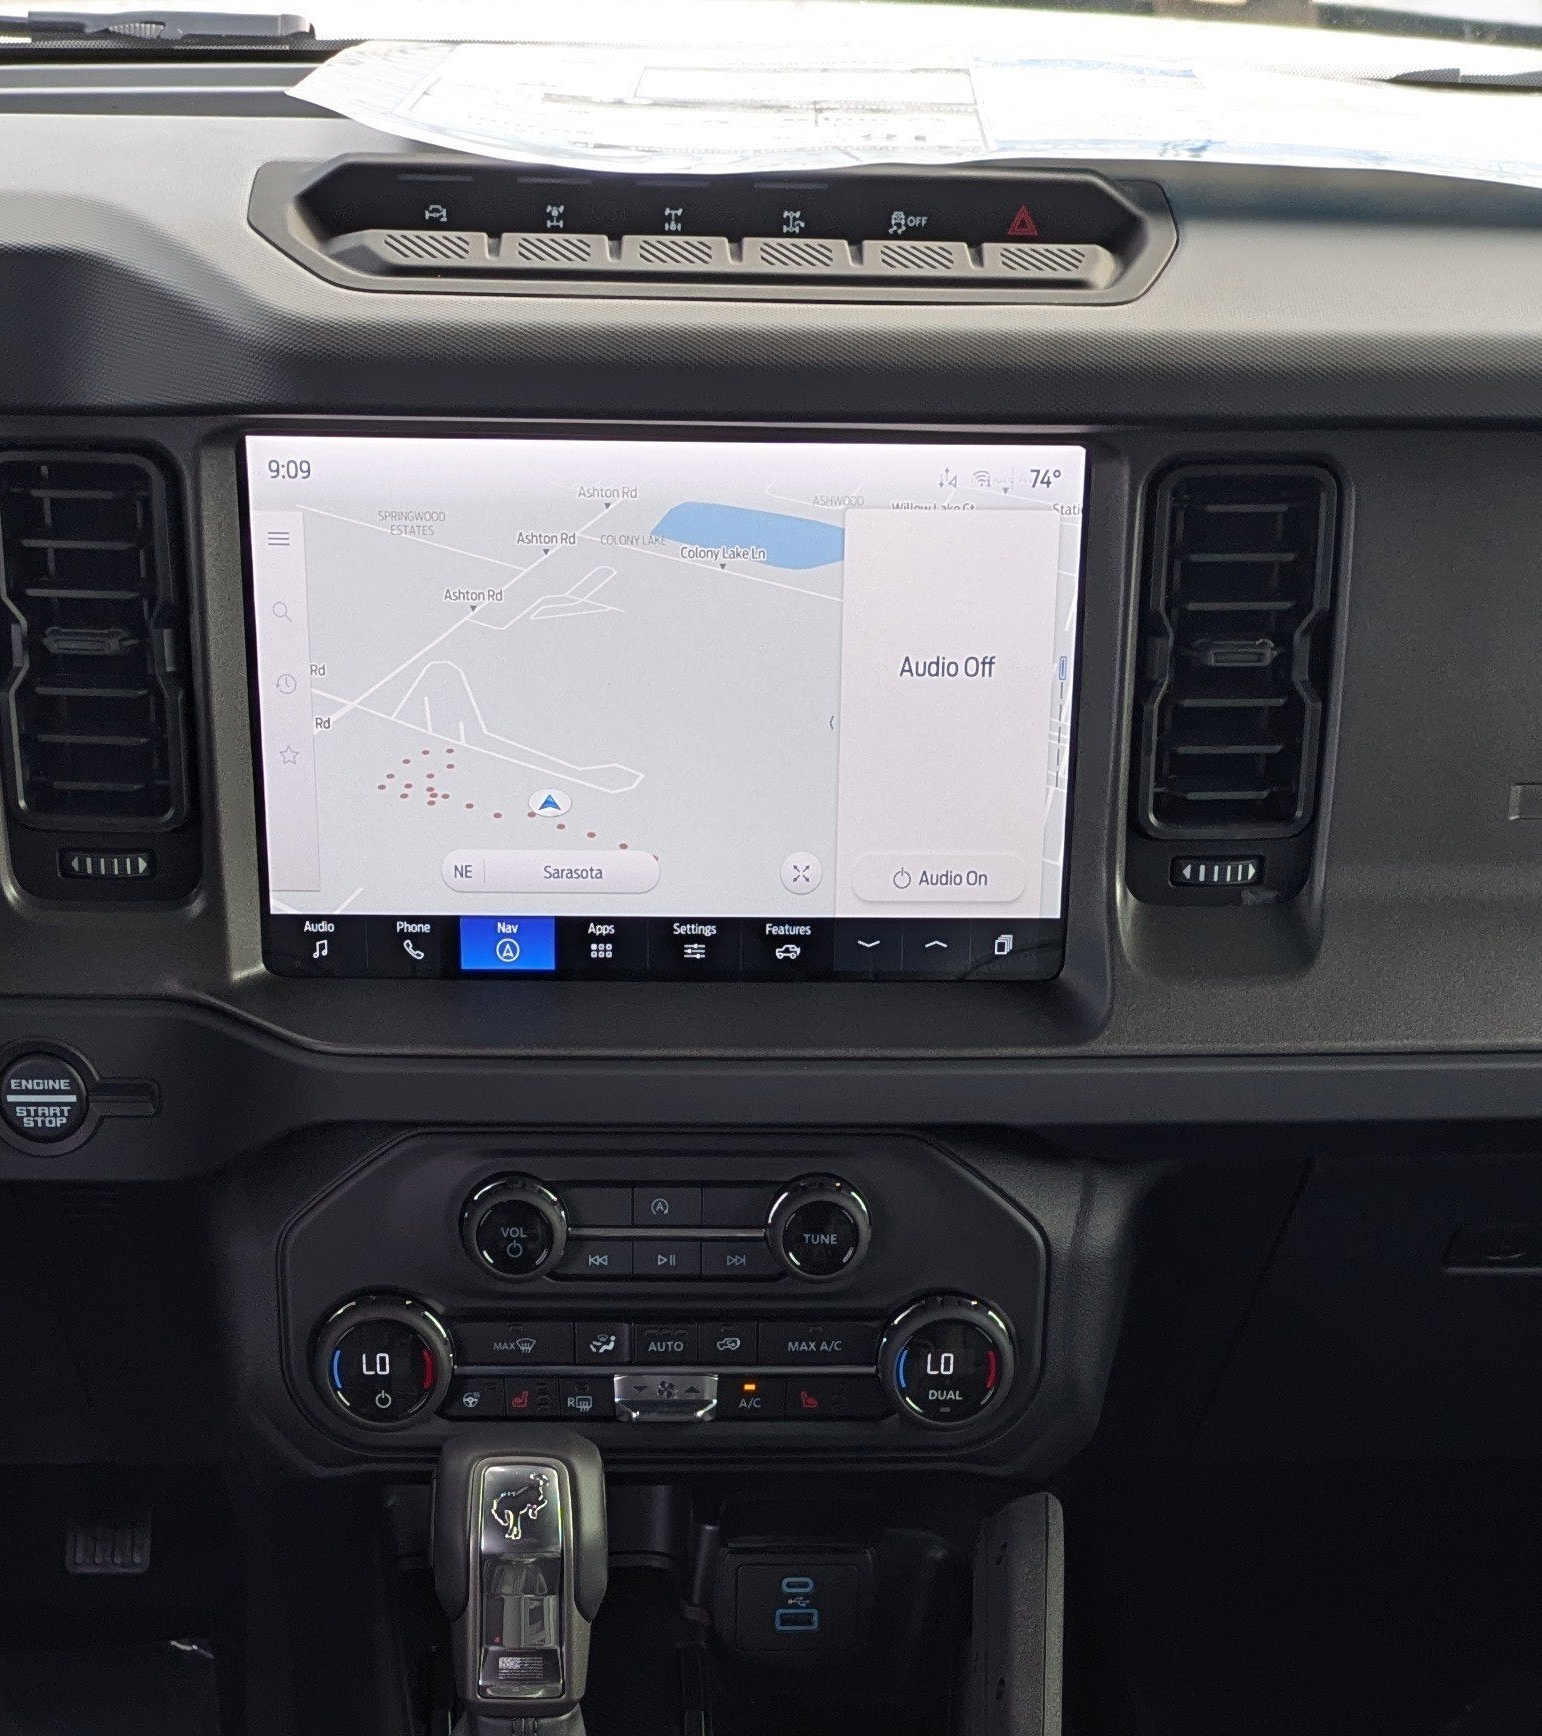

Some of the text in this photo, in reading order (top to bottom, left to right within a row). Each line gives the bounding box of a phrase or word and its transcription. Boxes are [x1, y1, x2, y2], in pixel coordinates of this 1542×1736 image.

[906, 215, 928, 227] OFF
[267, 459, 312, 480] 9:09
[1029, 468, 1062, 489] 74°
[577, 485, 638, 499] Ashton Rd
[377, 510, 446, 522] SPRINGWOOD
[390, 524, 435, 537] ESTATES
[516, 531, 576, 546] Ashton Rd
[600, 534, 667, 546] COLONY LAKE
[680, 546, 766, 561] Colony Lake Ln
[444, 588, 503, 602] Ashton Rd
[309, 663, 326, 678] Rd
[899, 656, 996, 678] Audio Off
[315, 717, 331, 730] Rd
[453, 865, 473, 879] NE
[543, 864, 603, 880] Sarasota
[918, 870, 988, 887] Audio On
[303, 920, 335, 933] Audio
[396, 921, 431, 934] Phone
[496, 922, 519, 934] Nav
[588, 922, 615, 937] Apps
[672, 922, 717, 937] Settings
[765, 923, 812, 936] Features
[10, 1078, 71, 1091] ENGINE
[15, 1106, 71, 1118] START
[23, 1116, 67, 1129] STOP
[500, 1227, 528, 1239] VOL
[803, 1233, 838, 1246] TUNE
[493, 1341, 515, 1351] MAX
[648, 1341, 684, 1352] AUTO
[787, 1341, 842, 1352] MAX A/C
[928, 1390, 963, 1401] DUAL
[738, 1397, 762, 1409] A/C
